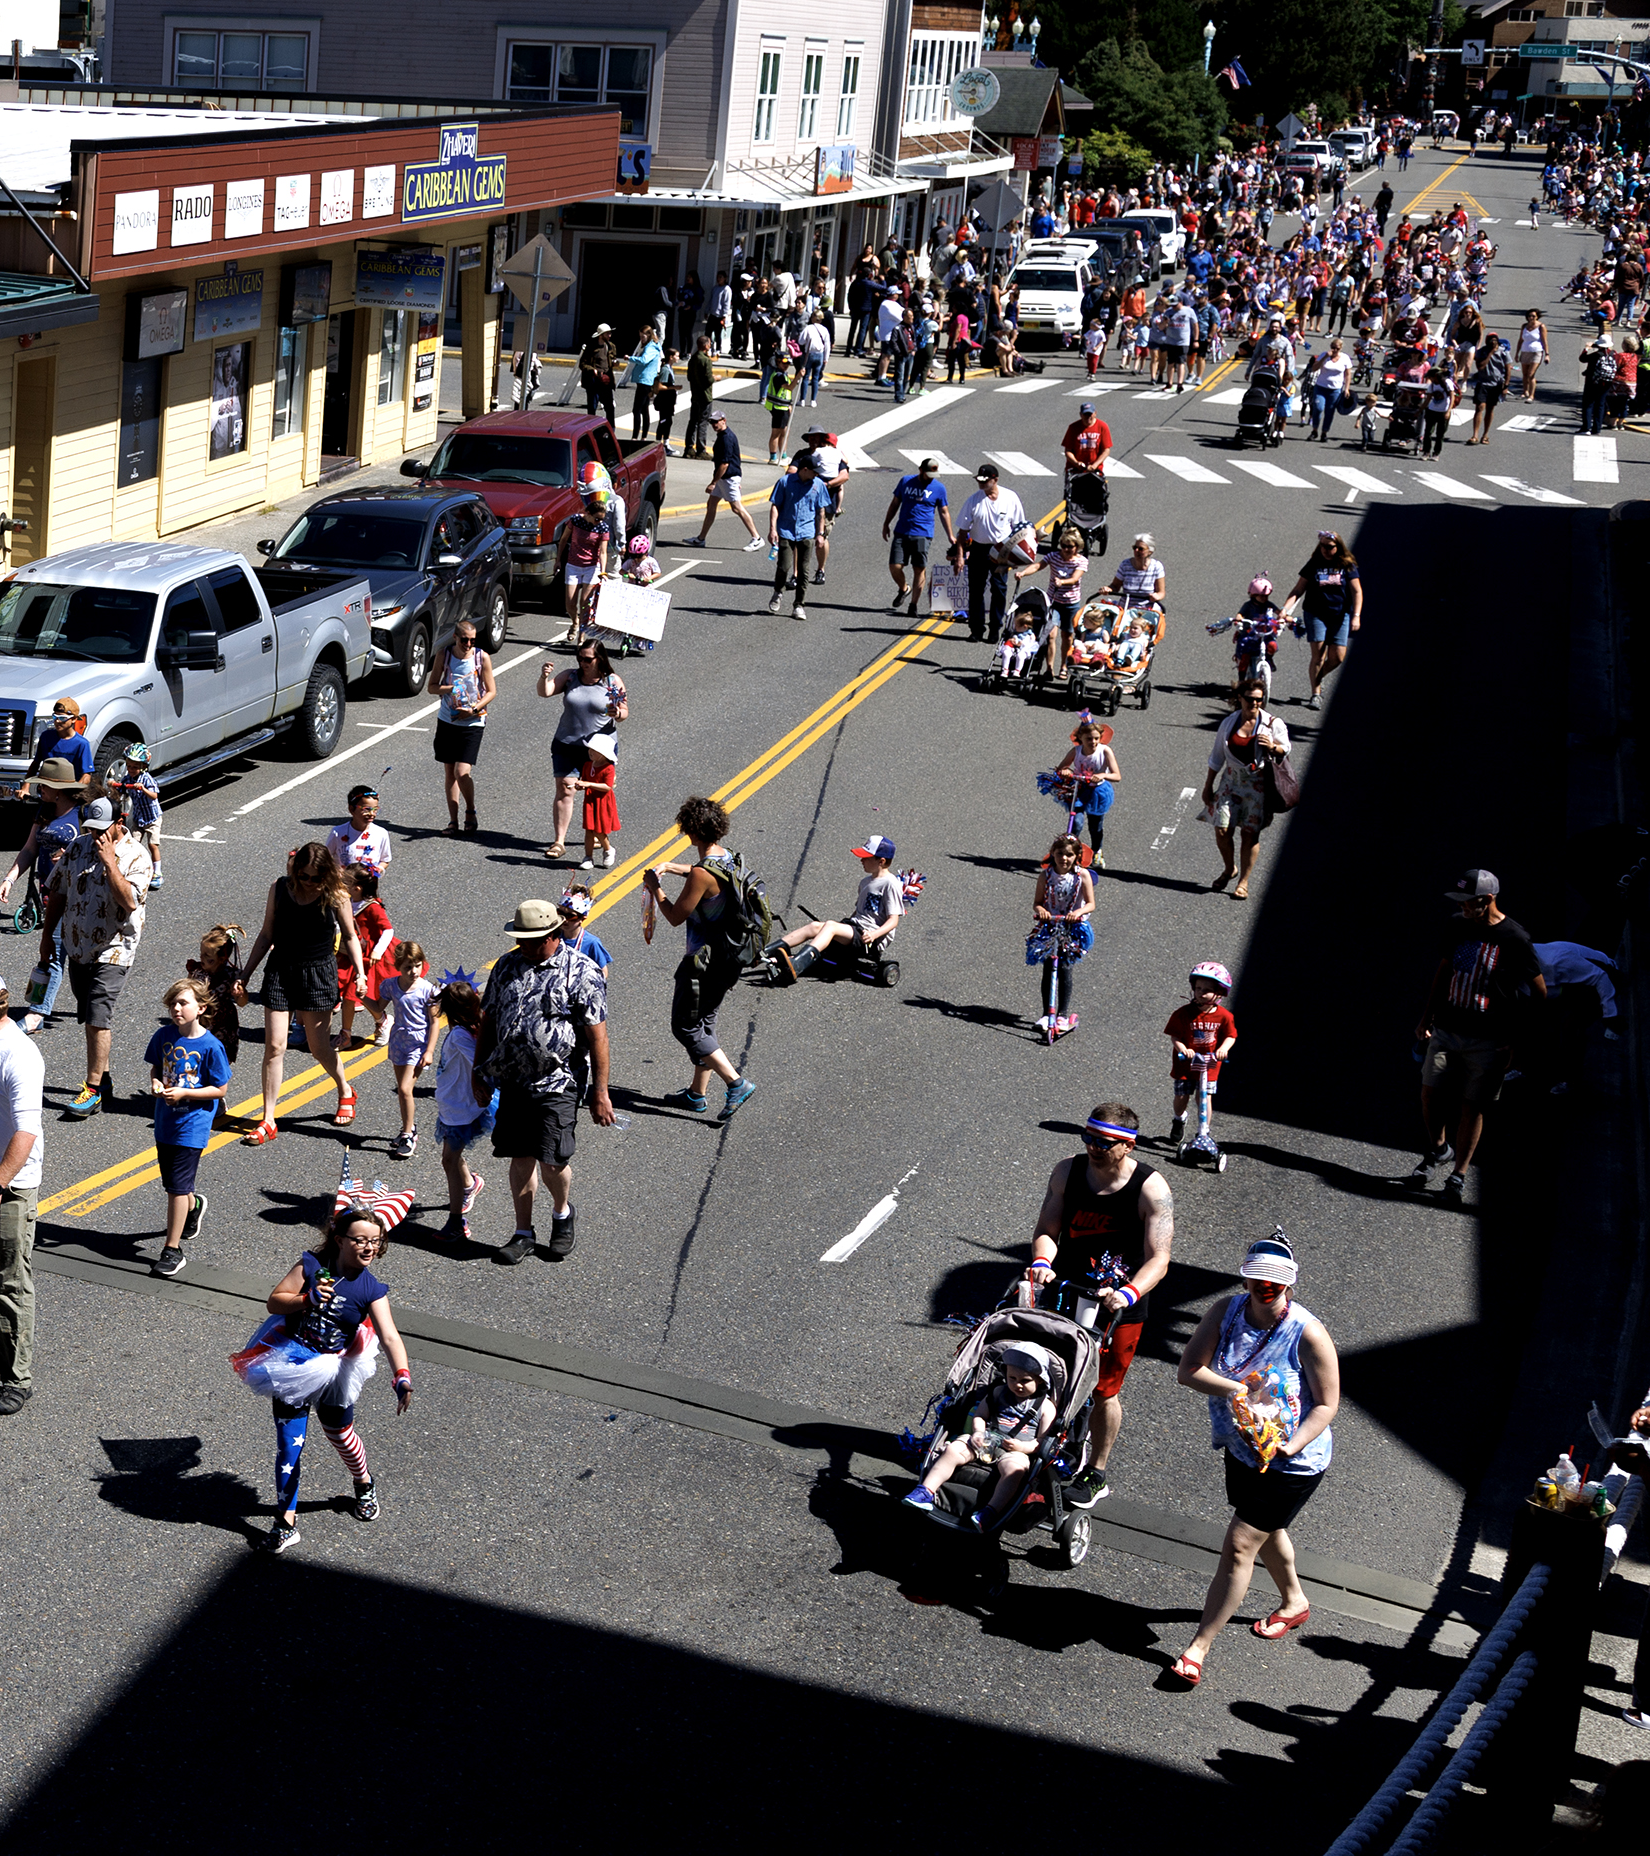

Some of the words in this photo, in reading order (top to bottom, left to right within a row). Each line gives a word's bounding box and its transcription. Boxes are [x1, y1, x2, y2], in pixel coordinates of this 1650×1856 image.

[1527, 46, 1558, 55] Bawden
[1561, 47, 1571, 55] St
[959, 71, 991, 87] Local
[441, 132, 476, 161] ZHAVERI
[406, 168, 472, 212] CARIBBEAN
[473, 164, 504, 202] GEMS
[174, 195, 212, 222] RADO
[228, 194, 263, 211] LONGINES
[322, 200, 351, 222] OMEGA
[115, 211, 157, 230] PANDORA
[360, 262, 411, 275] CARIBBEAN
[414, 266, 441, 278] GEMS
[198, 276, 240, 302] CARIBBEAN
[241, 272, 264, 295] GEMS
[359, 297, 386, 305] CERTIFIED
[406, 301, 436, 309] DIAMONDS
[150, 326, 175, 344] OMEGA
[904, 486, 932, 499] NAVY
[933, 564, 951, 576] ITS
[946, 577, 961, 586] MY
[946, 586, 969, 598] BIRTH
[343, 601, 361, 615] XTR
[951, 597, 969, 608] TOD
[1190, 1022, 1204, 1031] OLD
[1204, 1022, 1222, 1031] NAVY
[1070, 1209, 1114, 1231] NIKE
